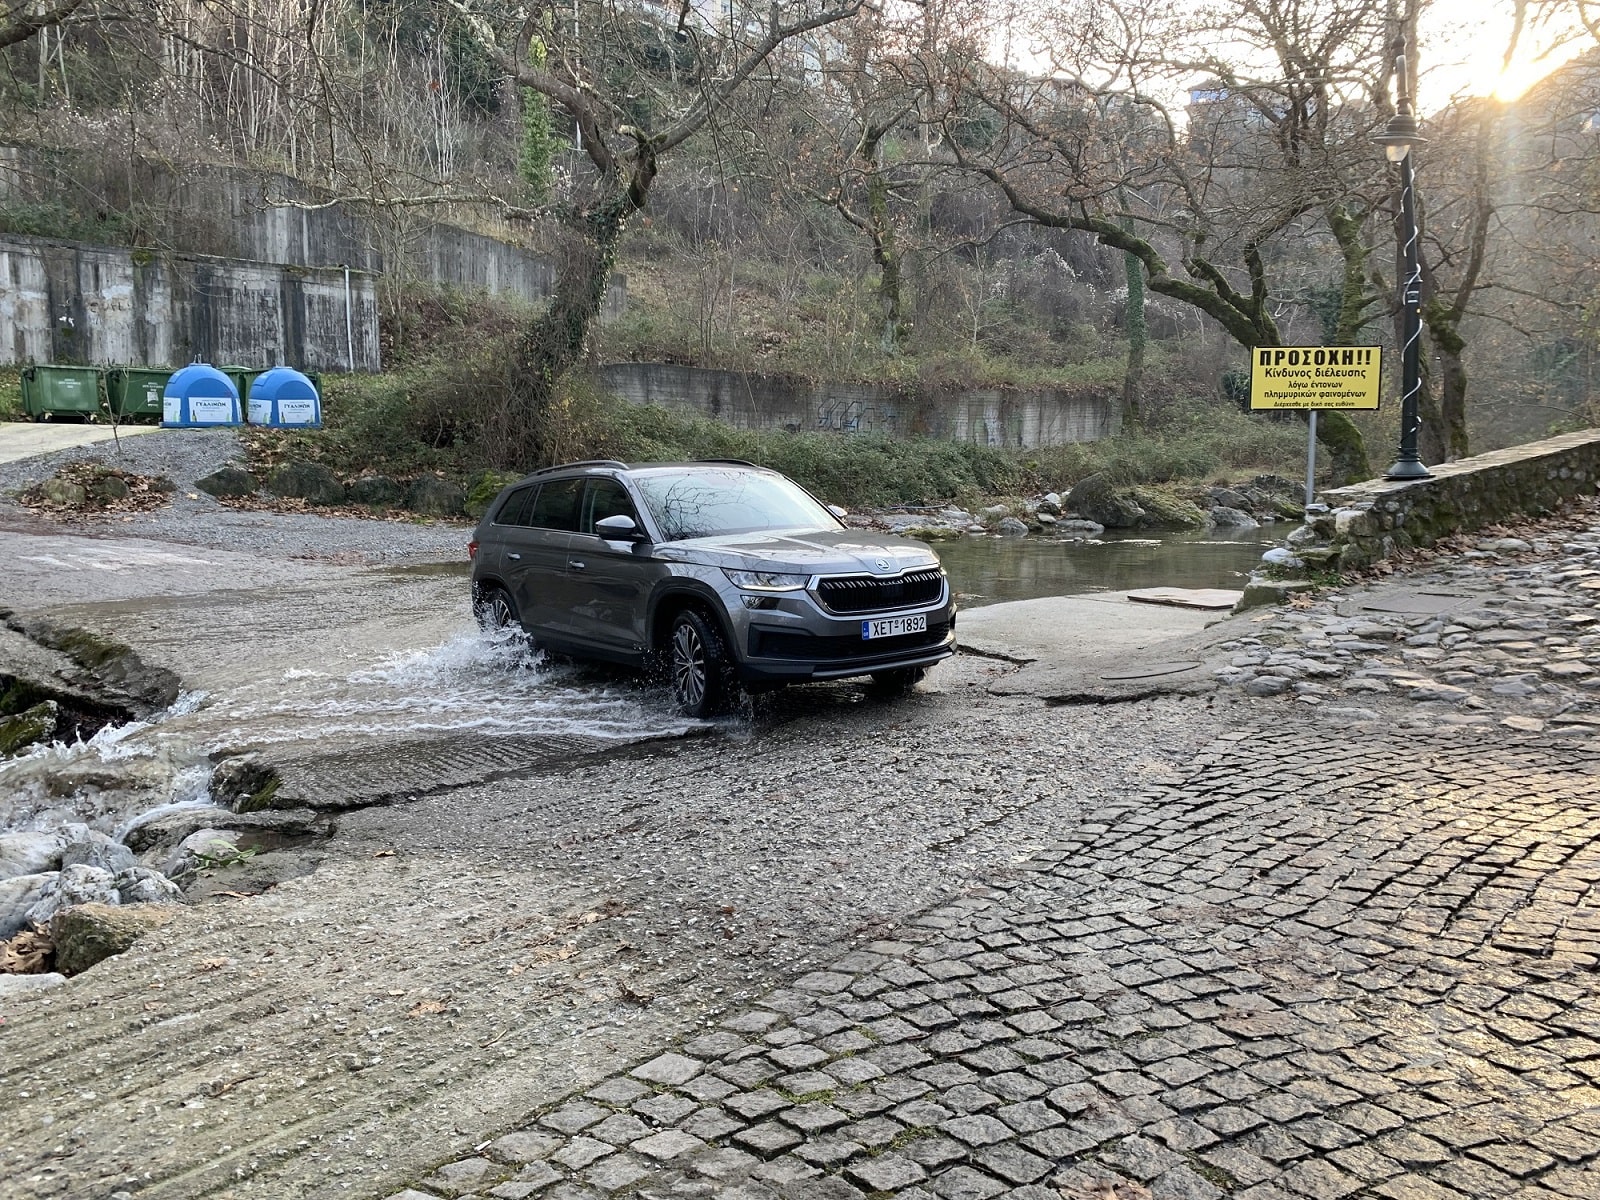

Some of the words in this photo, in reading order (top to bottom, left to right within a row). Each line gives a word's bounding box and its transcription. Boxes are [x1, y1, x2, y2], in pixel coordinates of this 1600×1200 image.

[1260, 350, 1371, 366] ΠΡΟΣΟΧΗ!!
[1265, 368, 1311, 379] Κίνδυνος
[1315, 368, 1366, 379] διέλευσης
[1288, 380, 1308, 390] λόγω
[1311, 380, 1343, 388] έντονων
[1264, 390, 1316, 400] πλημμυρικών
[1318, 390, 1366, 400] φαινομένων
